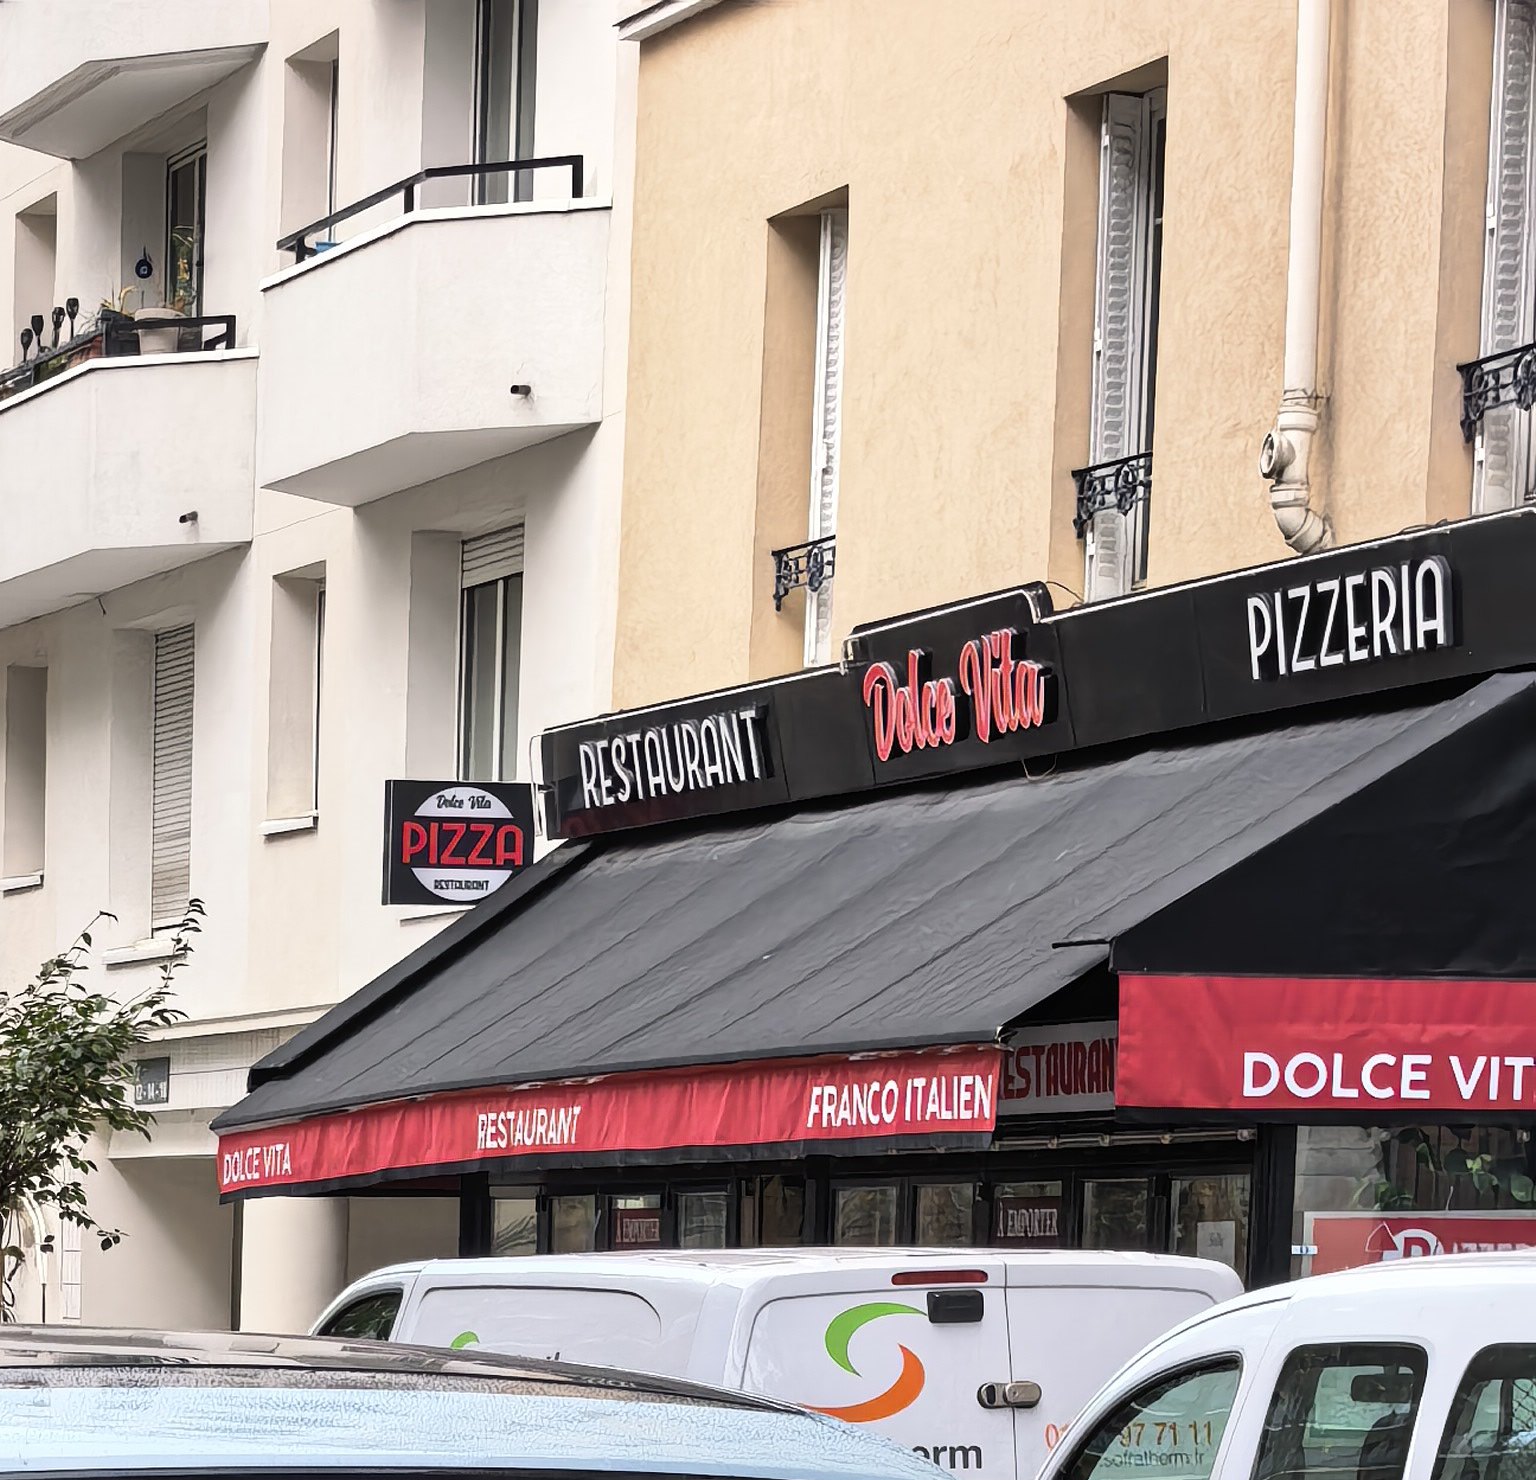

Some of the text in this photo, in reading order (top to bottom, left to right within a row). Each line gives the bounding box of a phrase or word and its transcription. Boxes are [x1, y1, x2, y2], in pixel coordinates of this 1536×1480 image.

[1247, 557, 1446, 680] PIZZERIA
[864, 627, 1047, 762] Dolce Vita
[578, 708, 762, 809] RESTAURANT
[436, 794, 492, 810] Dolce Vita
[402, 821, 524, 866] PIZZA
[434, 879, 490, 891] RESTAURANT
[1002, 1038, 1118, 1100] ESTAURAN
[1243, 1051, 1536, 1101] DOLCE VIT
[807, 1074, 993, 1128] FRANCO ITALIEN
[477, 1106, 582, 1150] RESTAURANT
[223, 1143, 293, 1185] DOLCE VITA
[1154, 1421, 1178, 1446] 71
[1188, 1420, 1212, 1445] 11
